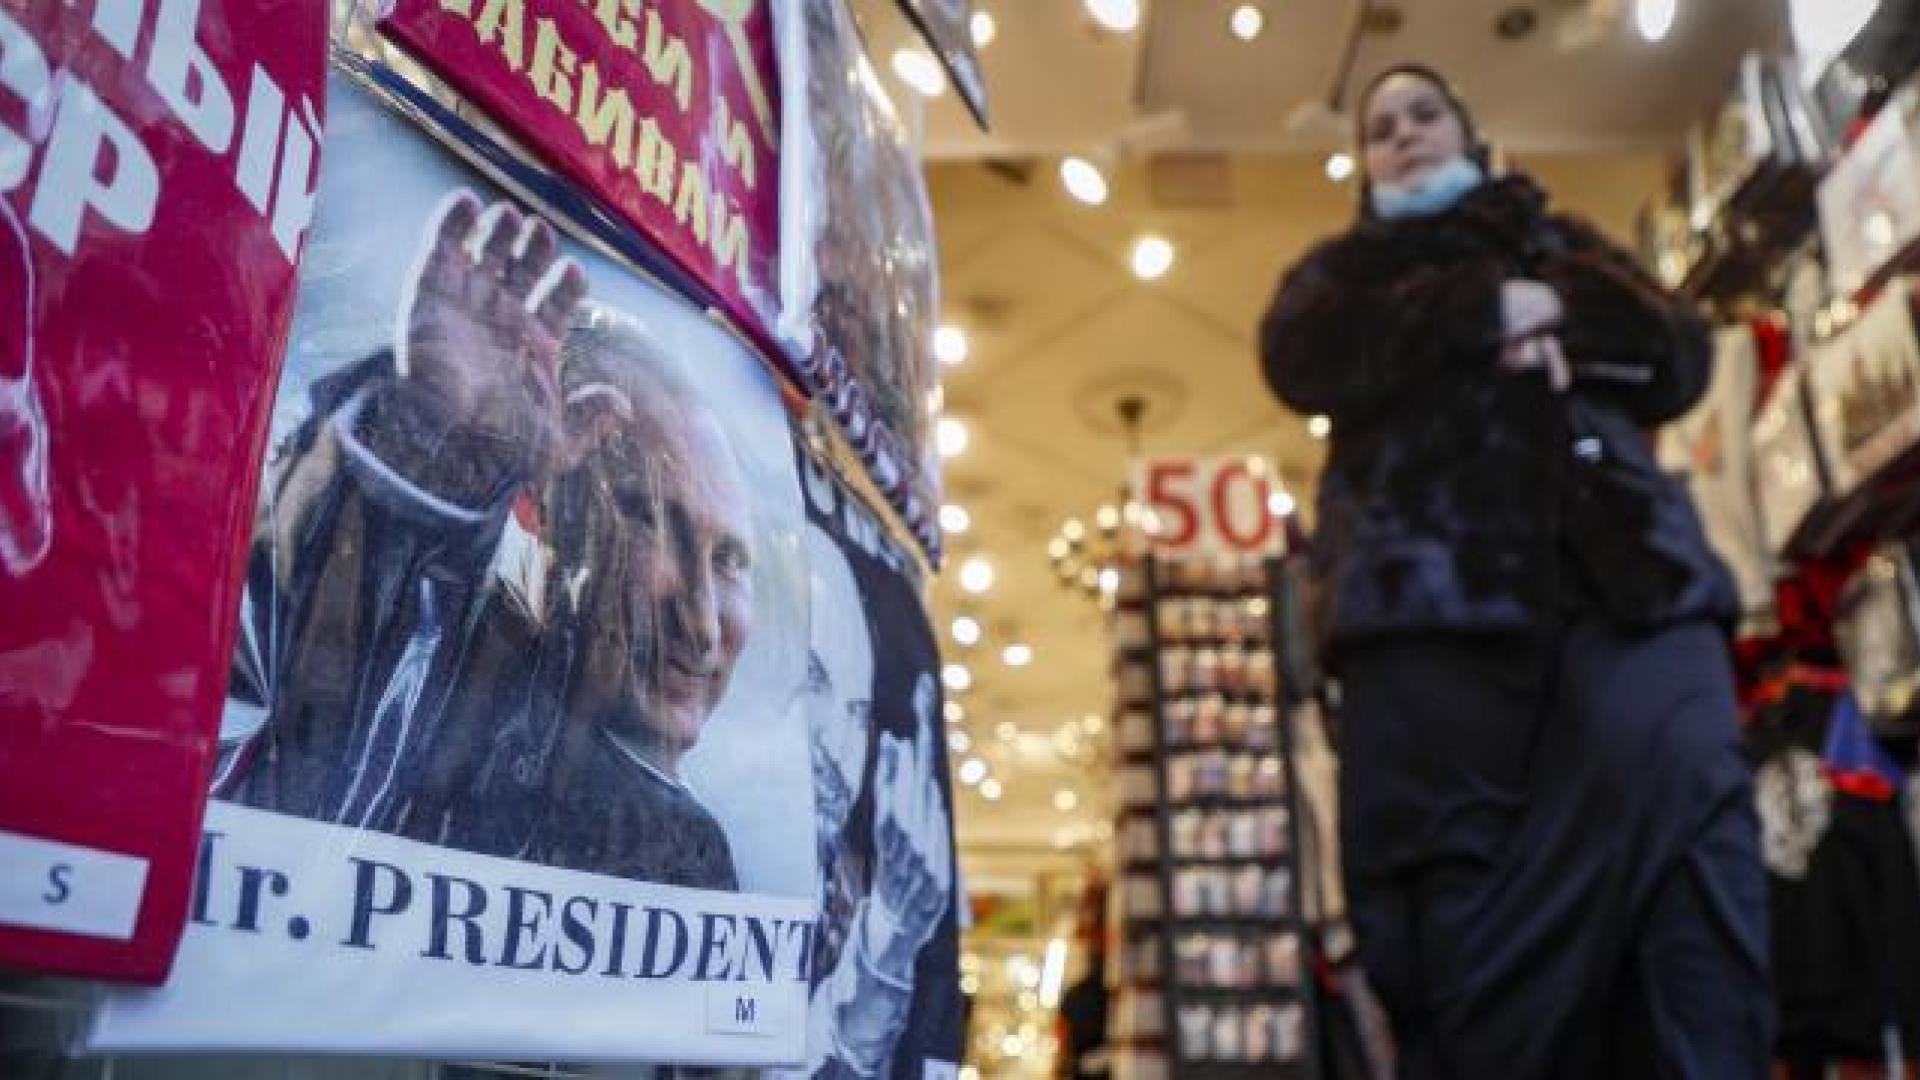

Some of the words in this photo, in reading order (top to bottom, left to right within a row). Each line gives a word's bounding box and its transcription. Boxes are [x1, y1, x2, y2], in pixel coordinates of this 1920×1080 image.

[439, 0, 752, 292] АБИВАЙ
[1145, 460, 1274, 550] 50
[42, 863, 74, 906] S
[339, 856, 816, 984] PRESIDENT
[735, 996, 756, 1023] M
